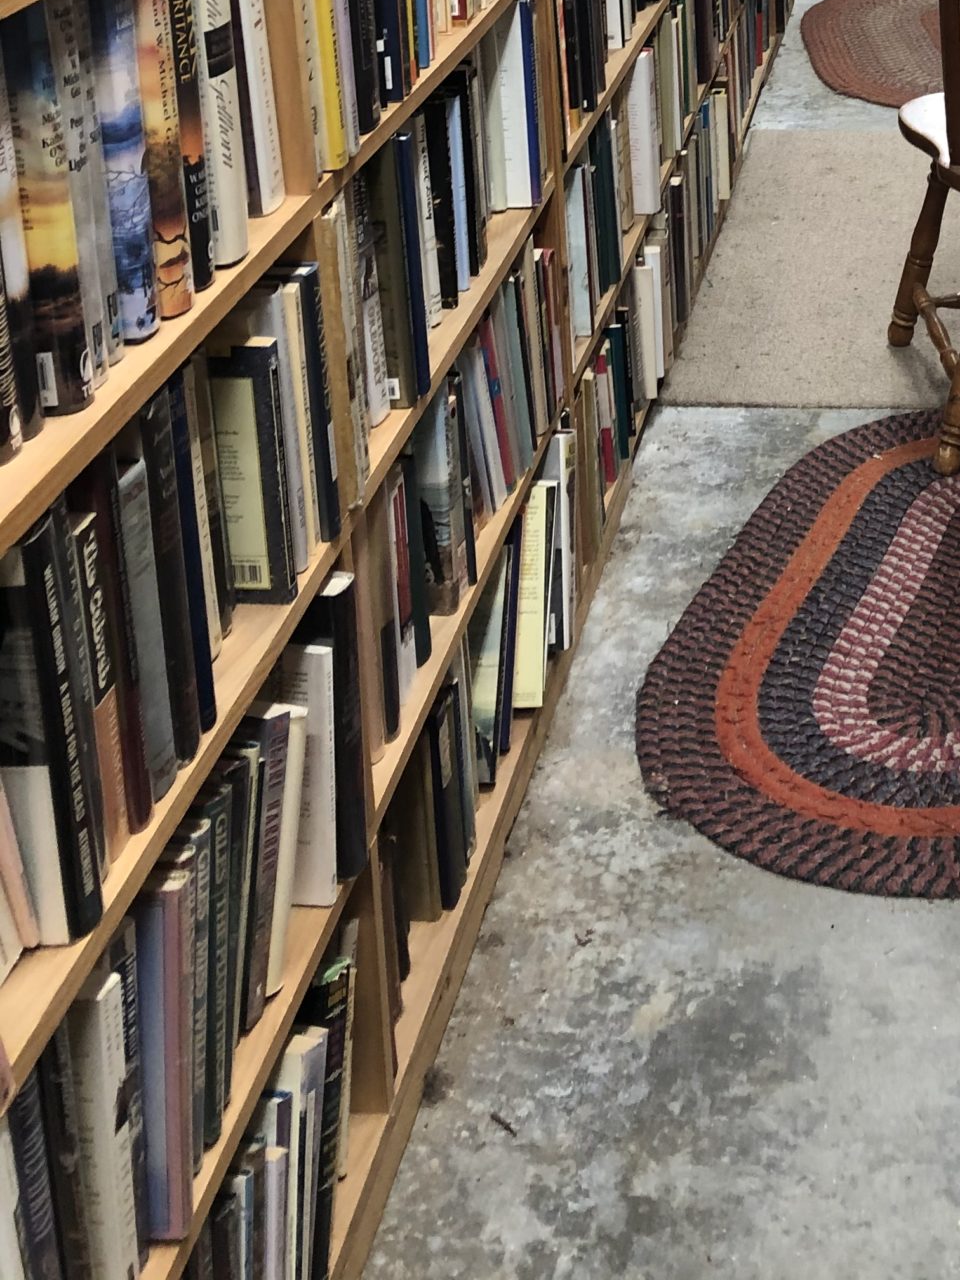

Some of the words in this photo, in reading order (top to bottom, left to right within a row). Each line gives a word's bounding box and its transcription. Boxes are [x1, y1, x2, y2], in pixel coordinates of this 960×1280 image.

[158, 60, 171, 122] Michael
[210, 78, 235, 171] Gellhorn
[313, 286, 333, 412] ANABASIS
[304, 422, 314, 462] With
[43, 562, 61, 625] WILLIAM
[51, 626, 67, 677] GIBSON
[61, 694, 75, 733] MASS
[66, 733, 77, 759] FOR
[69, 761, 80, 791] THE
[73, 791, 87, 823] DEAD
[213, 815, 230, 888] GILES
[193, 847, 212, 922] GILES
[193, 937, 210, 999] MISS
